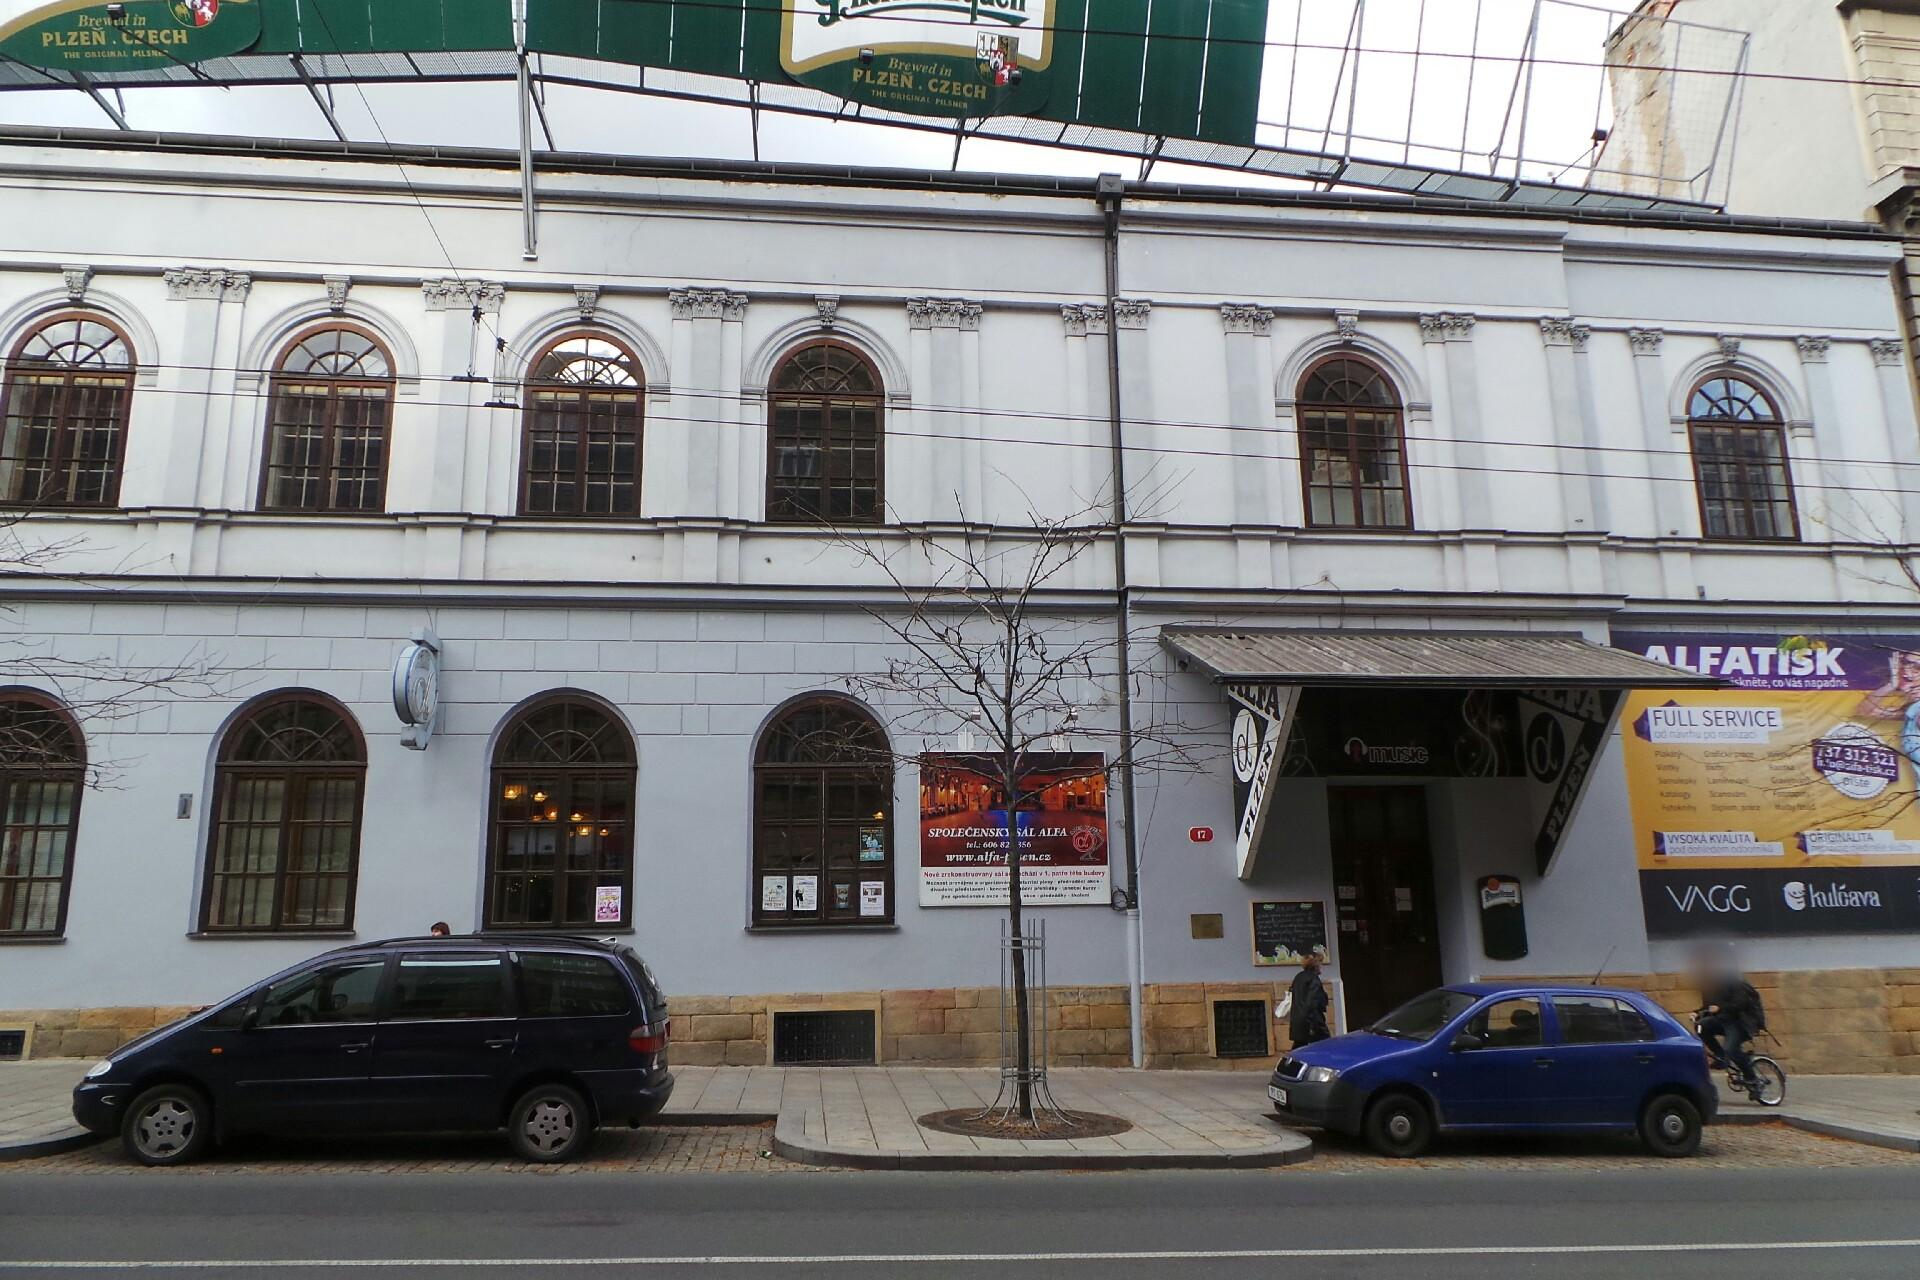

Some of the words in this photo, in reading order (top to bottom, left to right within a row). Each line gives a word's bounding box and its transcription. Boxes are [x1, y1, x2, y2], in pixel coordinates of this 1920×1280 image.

[133, 14, 146, 26] in
[42, 27, 107, 46] PLZEŇ
[122, 29, 188, 45] CZECH
[64, 51, 81, 59] THE
[85, 50, 128, 58] ORIGINAL
[888, 58, 938, 75] Brewed
[940, 66, 953, 78] in
[852, 68, 914, 89] PLZEŇ
[927, 77, 988, 99] CZECH
[871, 89, 888, 98] THE
[891, 93, 931, 103] ORIGINAL
[935, 98, 968, 109] PILSNER
[1645, 645, 1846, 676] ALFATISK
[1784, 677, 1803, 687] Vás
[1804, 678, 1849, 689] napadne
[1653, 710, 1699, 727] FULL
[1702, 710, 1778, 728] SERVICE
[1368, 745, 1430, 764] music
[1844, 747, 1869, 762] 312
[1871, 751, 1897, 766] 321
[1016, 825, 1037, 837] SÁL
[1038, 827, 1068, 837] ALFA
[1197, 829, 1207, 839] 17
[1709, 833, 1752, 845] KVALITA
[1808, 832, 1875, 843] ORIGINALITA
[982, 841, 998, 849] 606
[1084, 870, 1105, 878] budovy
